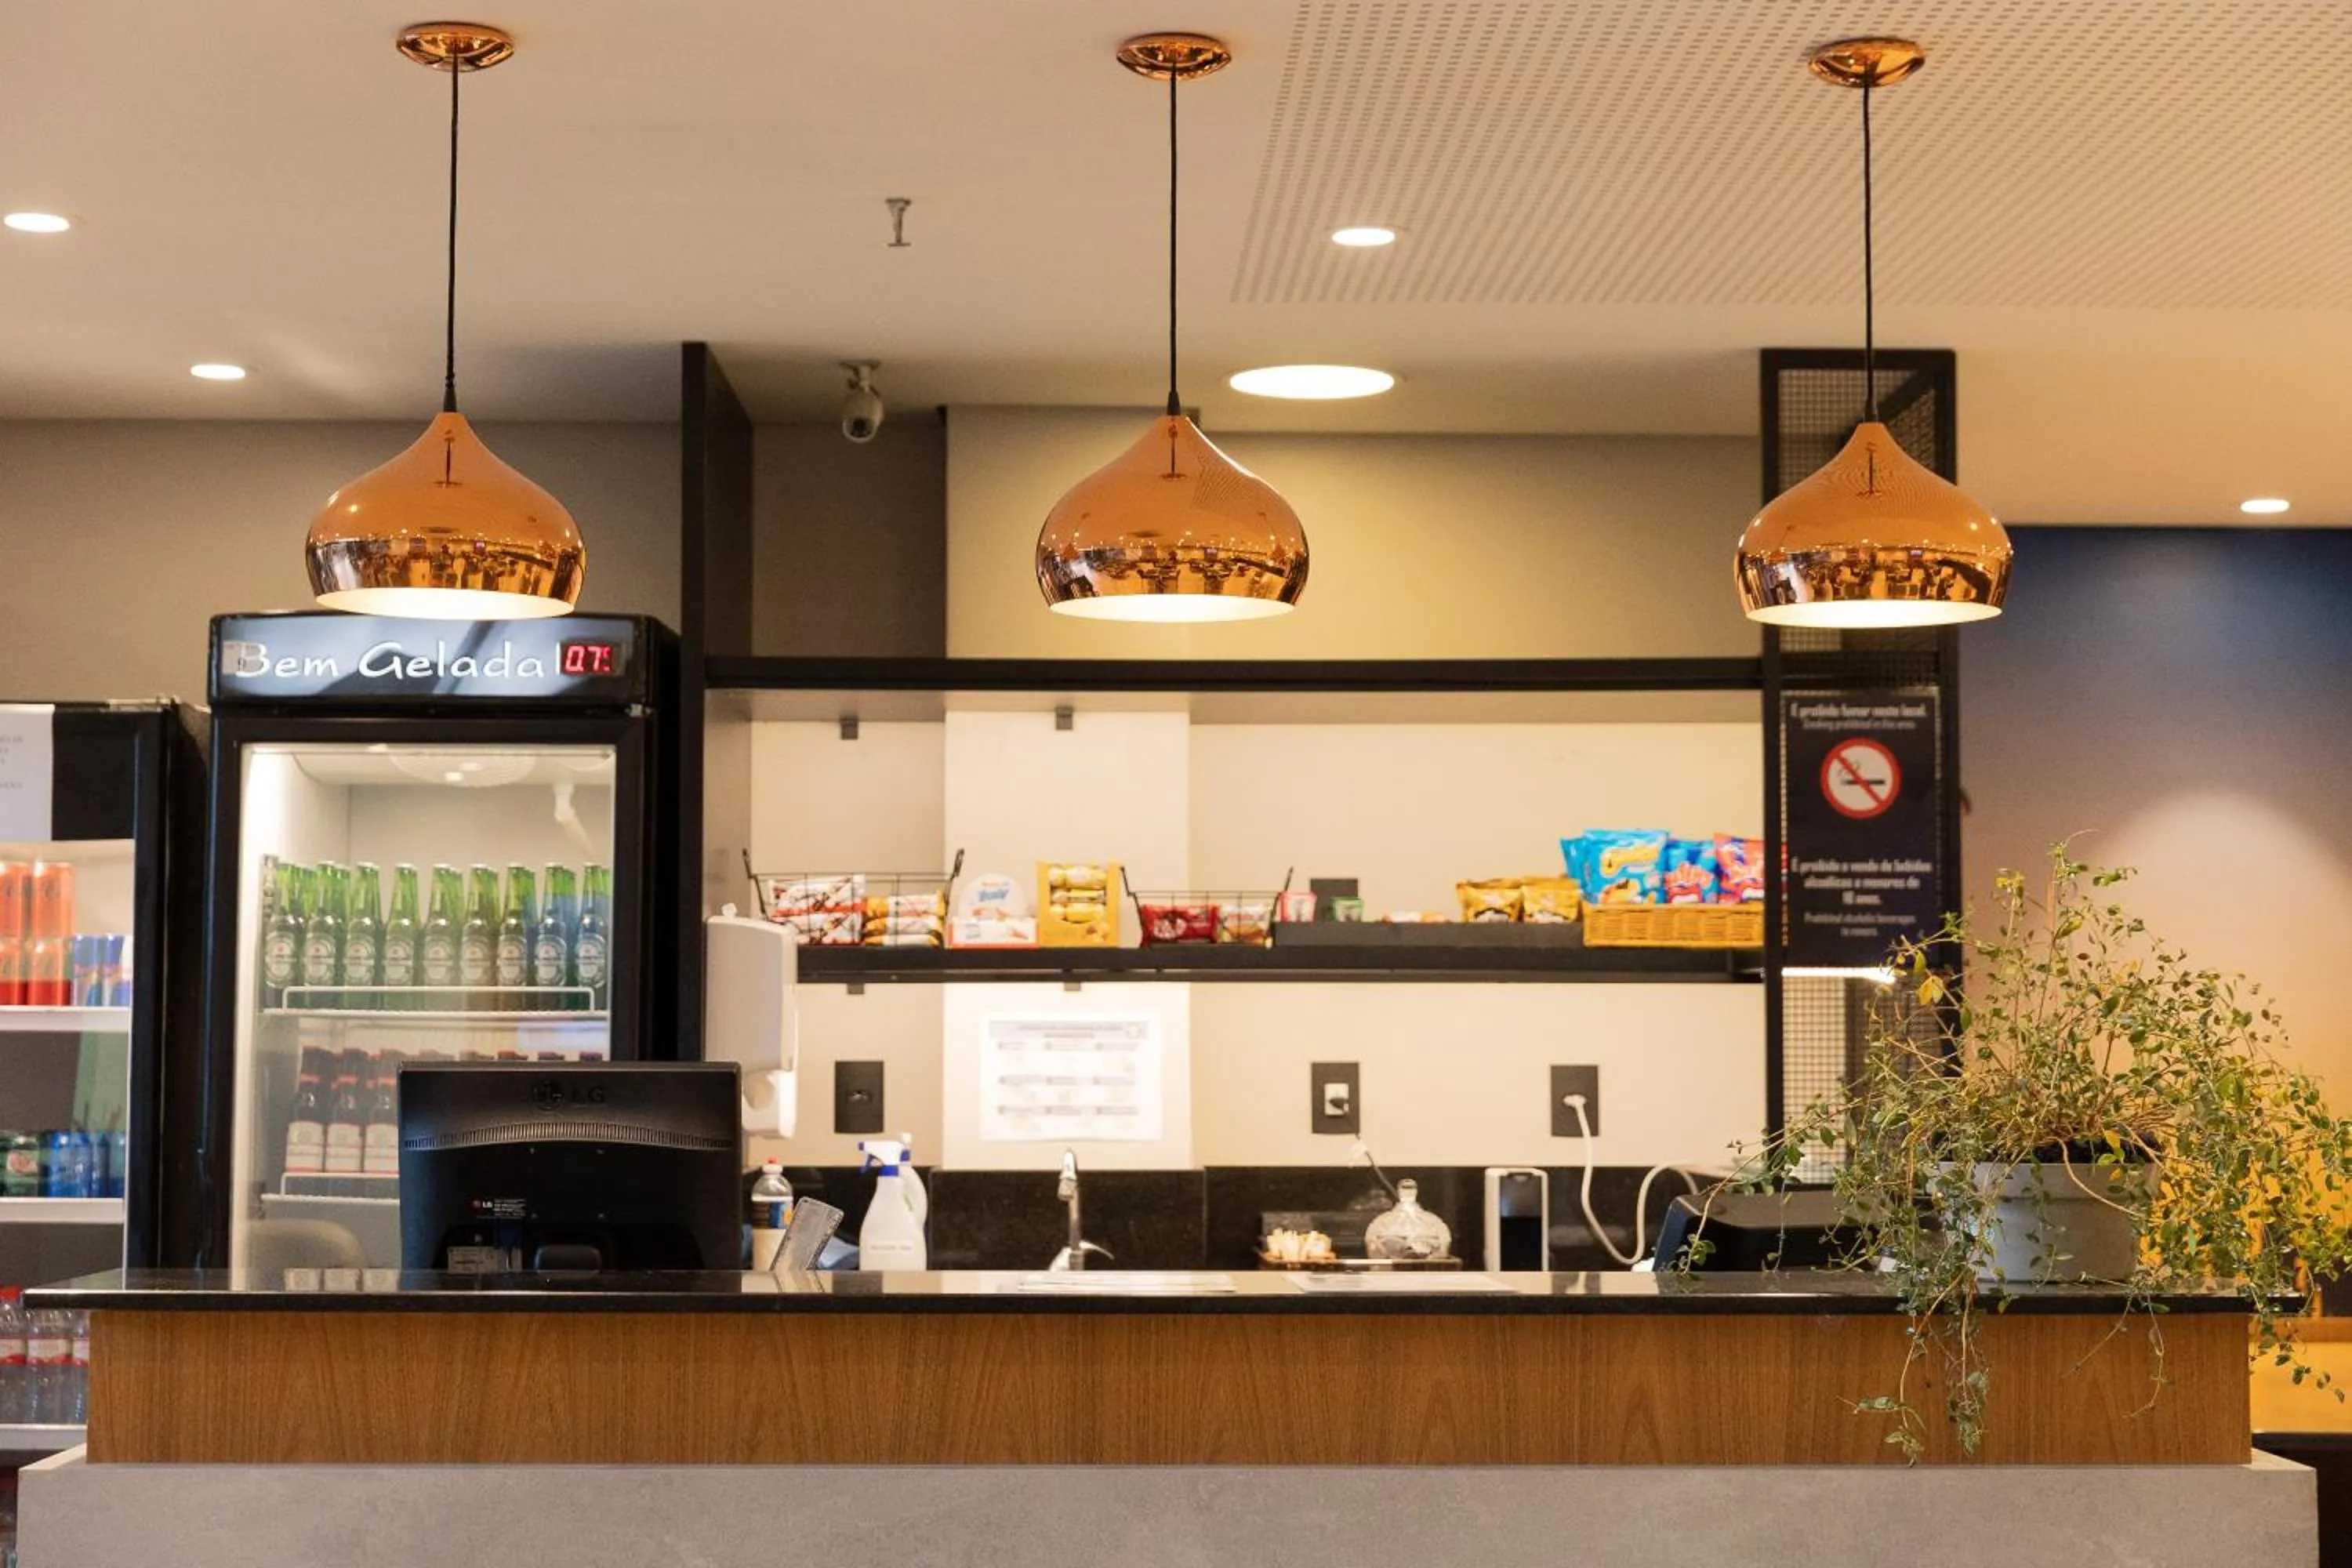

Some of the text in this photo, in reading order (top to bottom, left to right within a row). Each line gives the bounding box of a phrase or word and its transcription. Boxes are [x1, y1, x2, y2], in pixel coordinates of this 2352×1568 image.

[235, 641, 544, 679] Bem Gelada
[572, 1086, 607, 1105] LG
